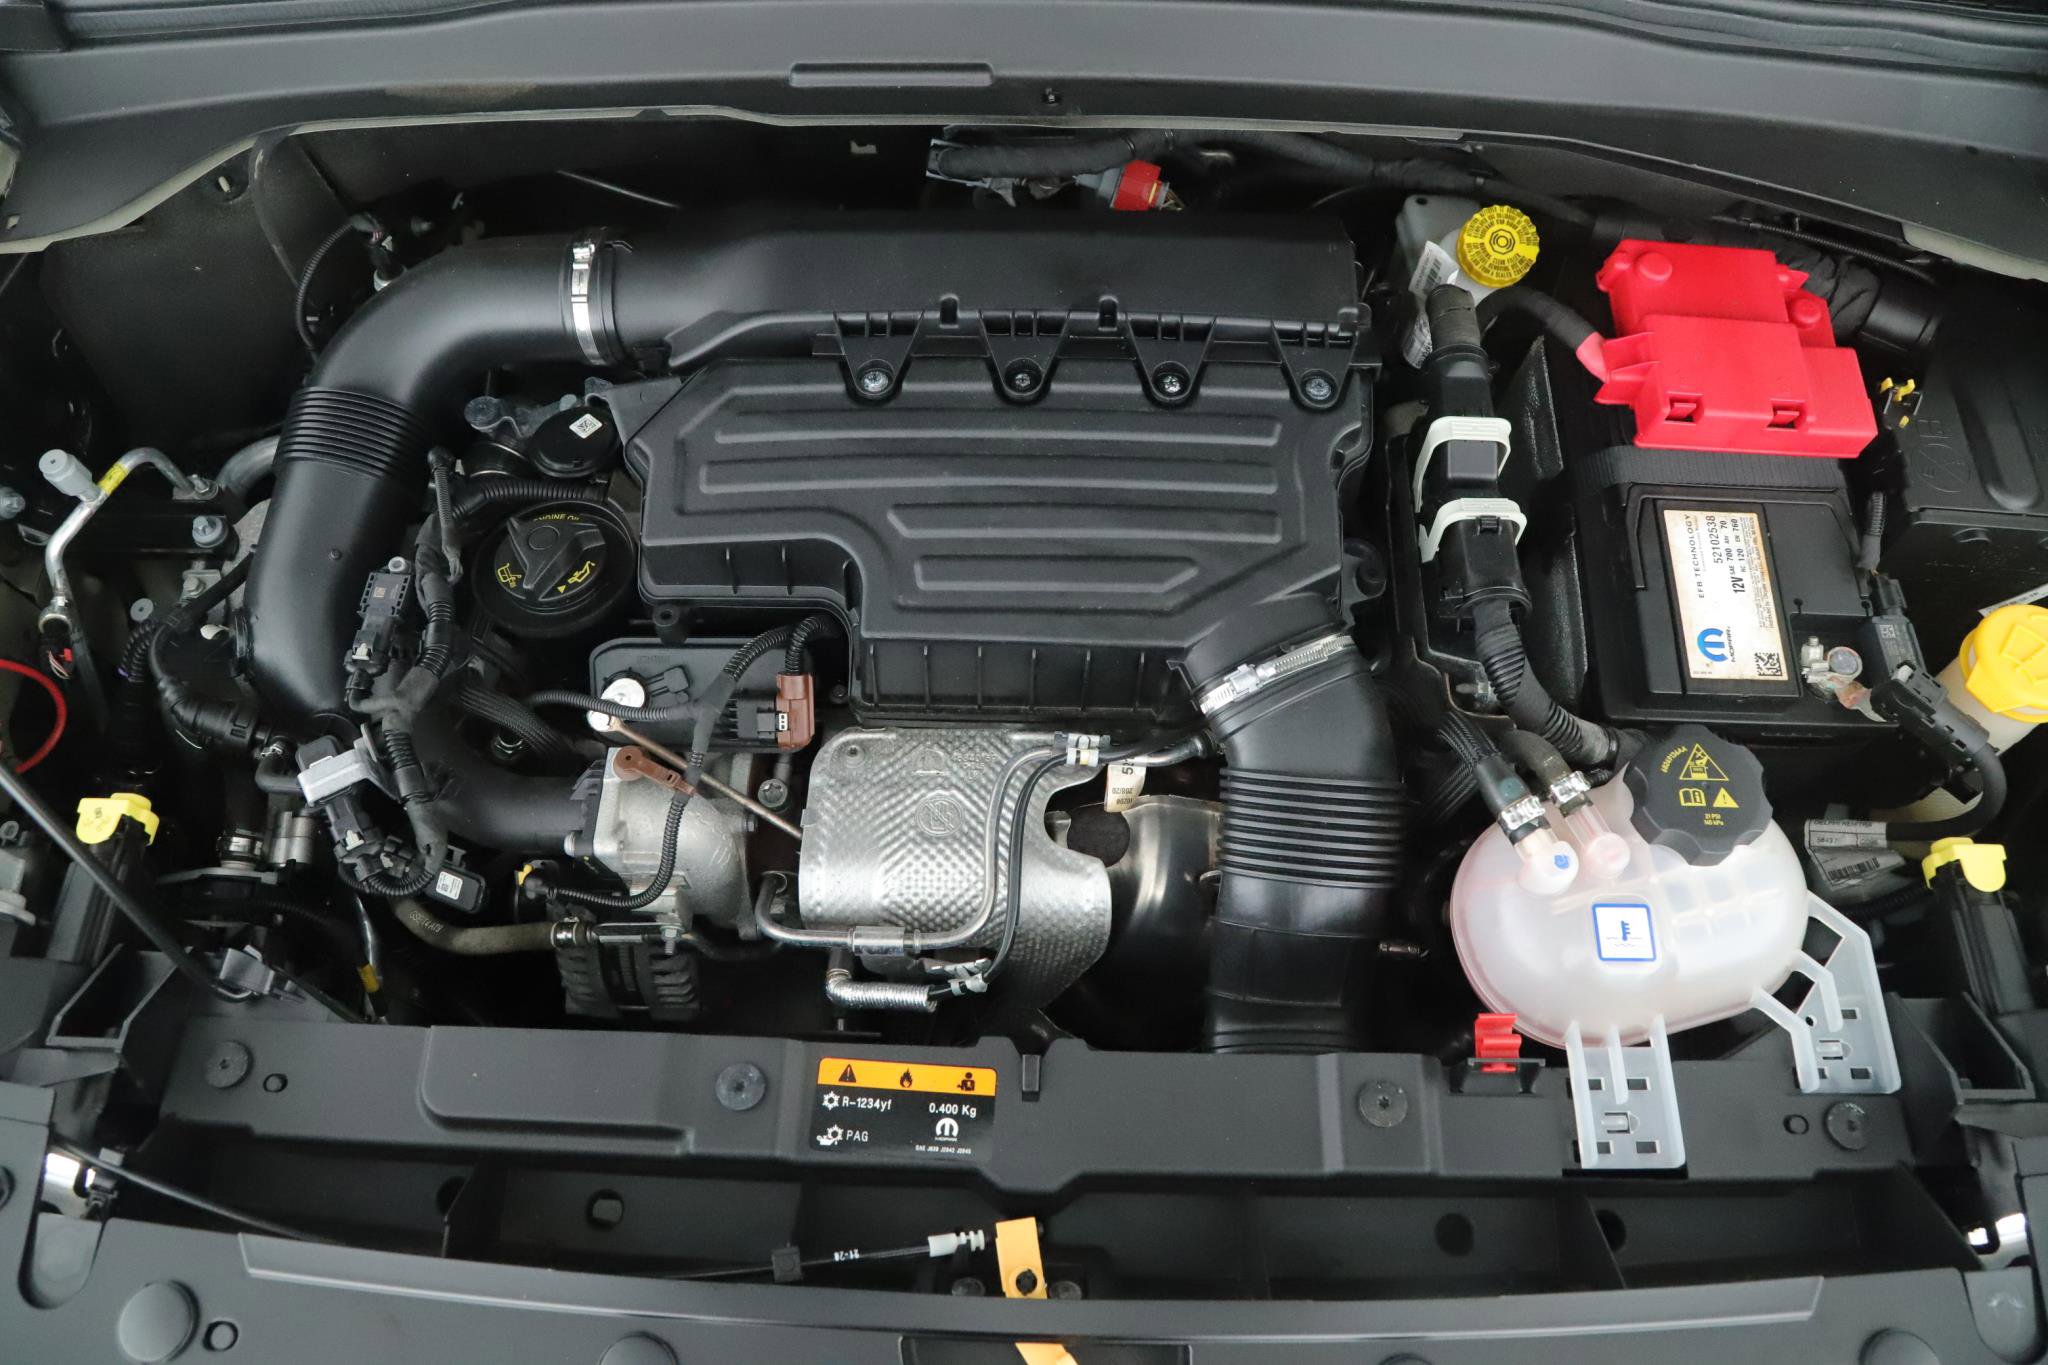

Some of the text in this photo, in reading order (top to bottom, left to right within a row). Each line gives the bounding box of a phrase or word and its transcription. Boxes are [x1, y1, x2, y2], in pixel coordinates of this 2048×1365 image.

[1720, 520, 1728, 529] 70
[1685, 515, 1700, 576] TECHNOLOGY
[1706, 516, 1724, 564] 52102538
[1726, 548, 1734, 561] 700
[1737, 548, 1745, 561] 120
[1731, 577, 1745, 593] 12V
[842, 1096, 892, 1112] R-1234yf
[929, 1102, 977, 1118] 0.400 Kg
[846, 1130, 869, 1142] PAG
